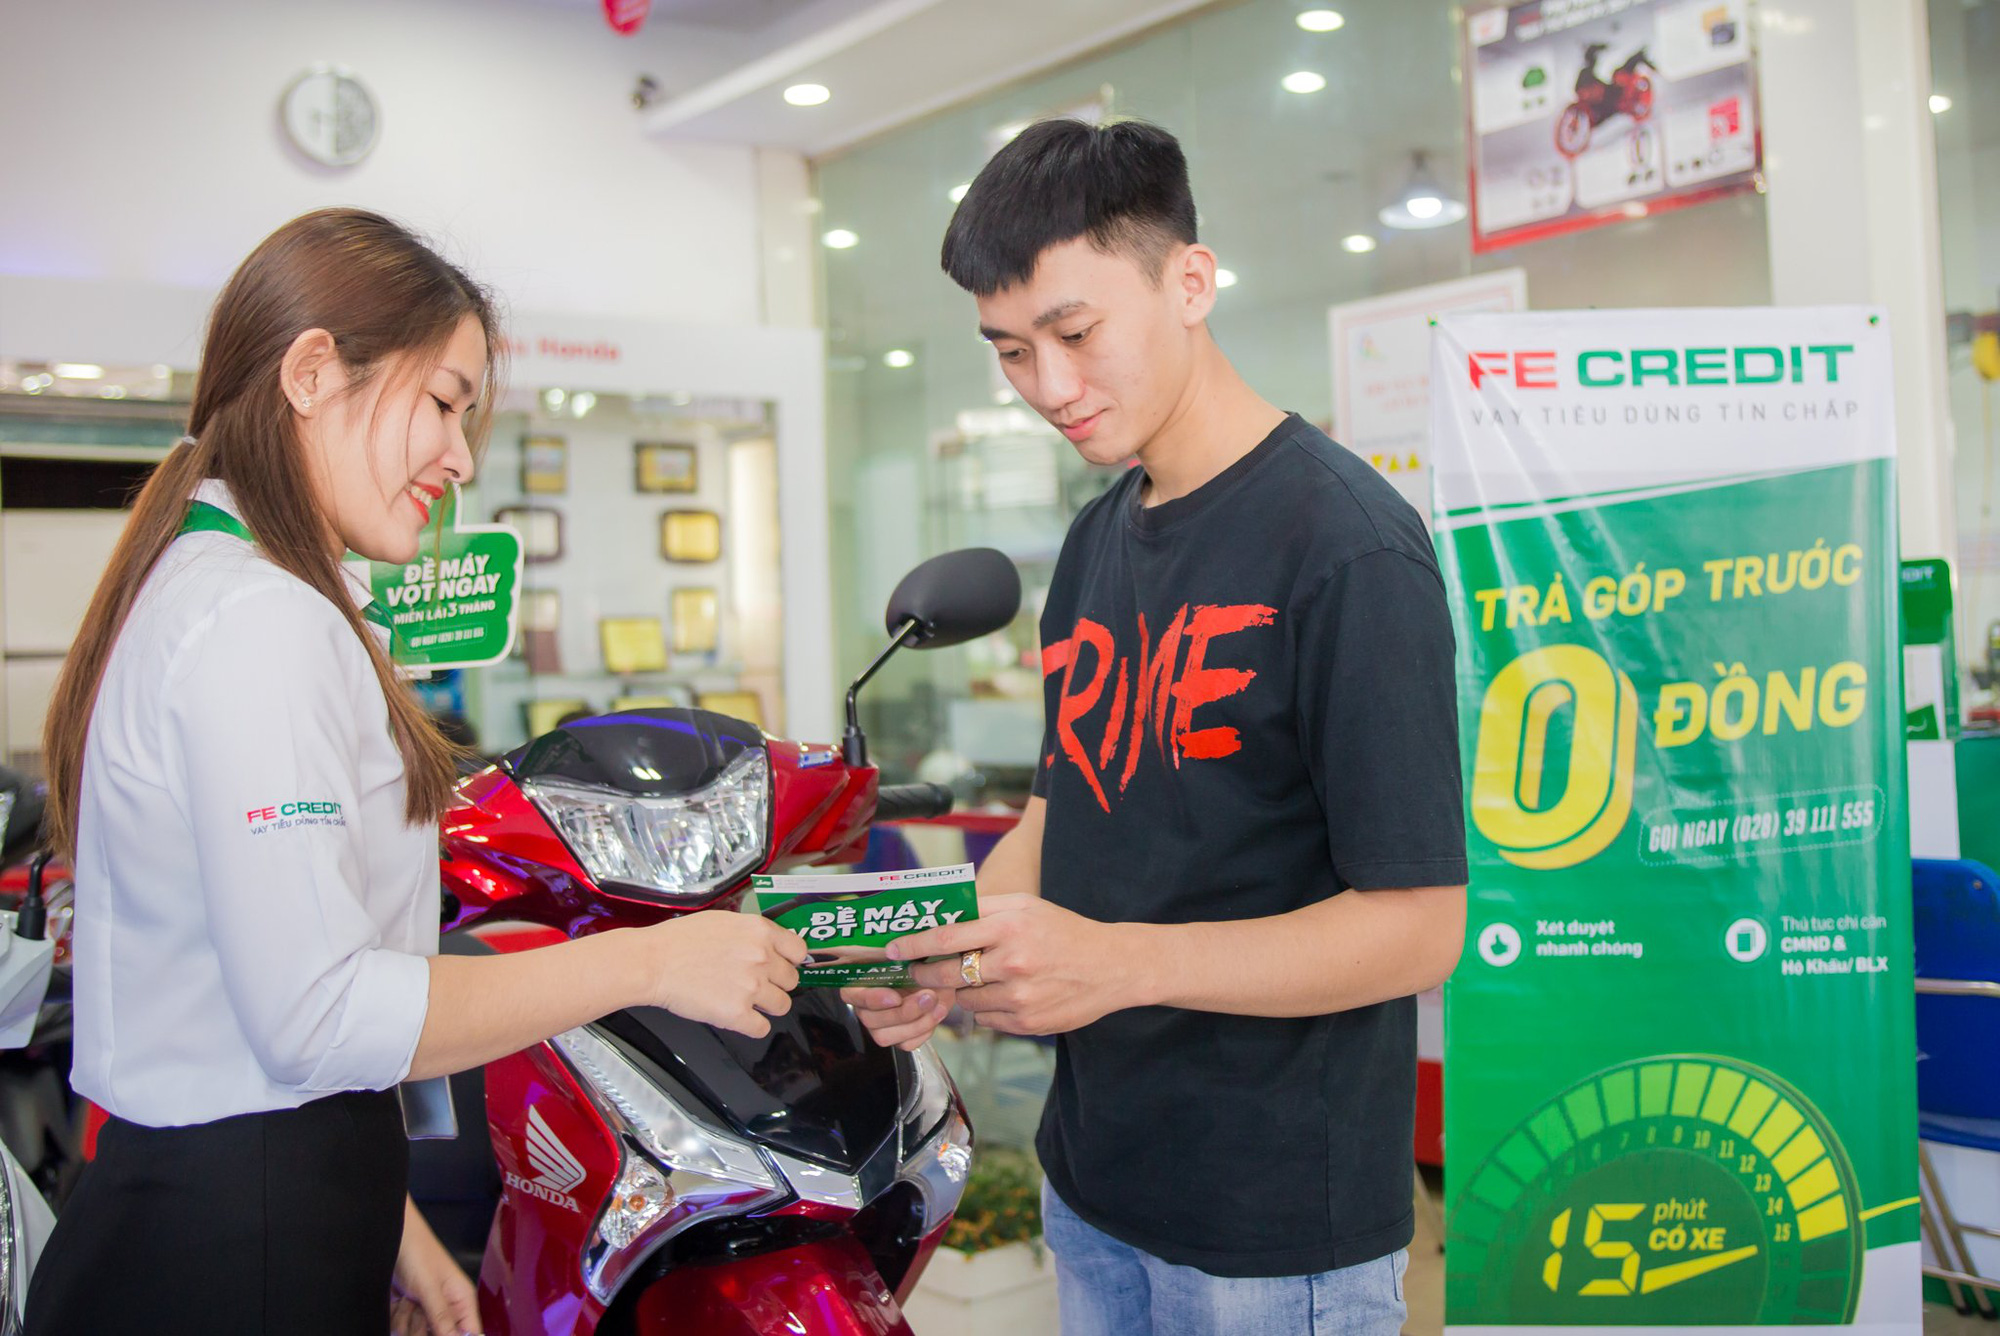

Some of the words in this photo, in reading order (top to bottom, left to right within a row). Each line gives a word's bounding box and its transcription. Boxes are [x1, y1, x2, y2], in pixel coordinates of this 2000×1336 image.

[1469, 351, 1557, 389] FE
[1578, 345, 1854, 386] CREDIT
[1472, 408, 1522, 426] VAY
[404, 555, 436, 584] ĐỀ
[440, 552, 490, 579] MÁY
[386, 582, 436, 609] VỌT
[438, 573, 501, 600] NGAY
[1475, 571, 1572, 632] TRẢ
[1582, 561, 1686, 620] GÓP
[1703, 537, 1863, 602] TRƯỚC
[1471, 643, 1638, 869] 0
[1653, 661, 1868, 748] ĐỒNG
[247, 806, 277, 824] FE
[281, 801, 342, 816] CREDIT
[251, 824, 268, 836] VAY
[1682, 817, 1728, 849] NGAY
[1732, 811, 1779, 844] (028)
[1784, 807, 1806, 837] 39
[1810, 804, 1837, 833] 111
[1841, 800, 1874, 830] 555
[903, 868, 966, 880] CREDIT
[810, 906, 856, 926] ĐỀ
[863, 899, 944, 922] MÁY
[864, 910, 964, 935] NGAY
[1536, 940, 1589, 956] nhanh
[1832, 935, 1847, 951] &
[1693, 1129, 1711, 1149] 10
[1718, 1140, 1735, 1159] 11
[1739, 1154, 1756, 1173] 12
[506, 1172, 581, 1213] HONDA
[1754, 1173, 1772, 1192] 13
[1766, 1197, 1783, 1216] 14
[1648, 1222, 1687, 1251] CÓ
[1688, 1227, 1727, 1251] XE
[1773, 1223, 1791, 1242] 15
[1543, 1203, 1646, 1296] 15
